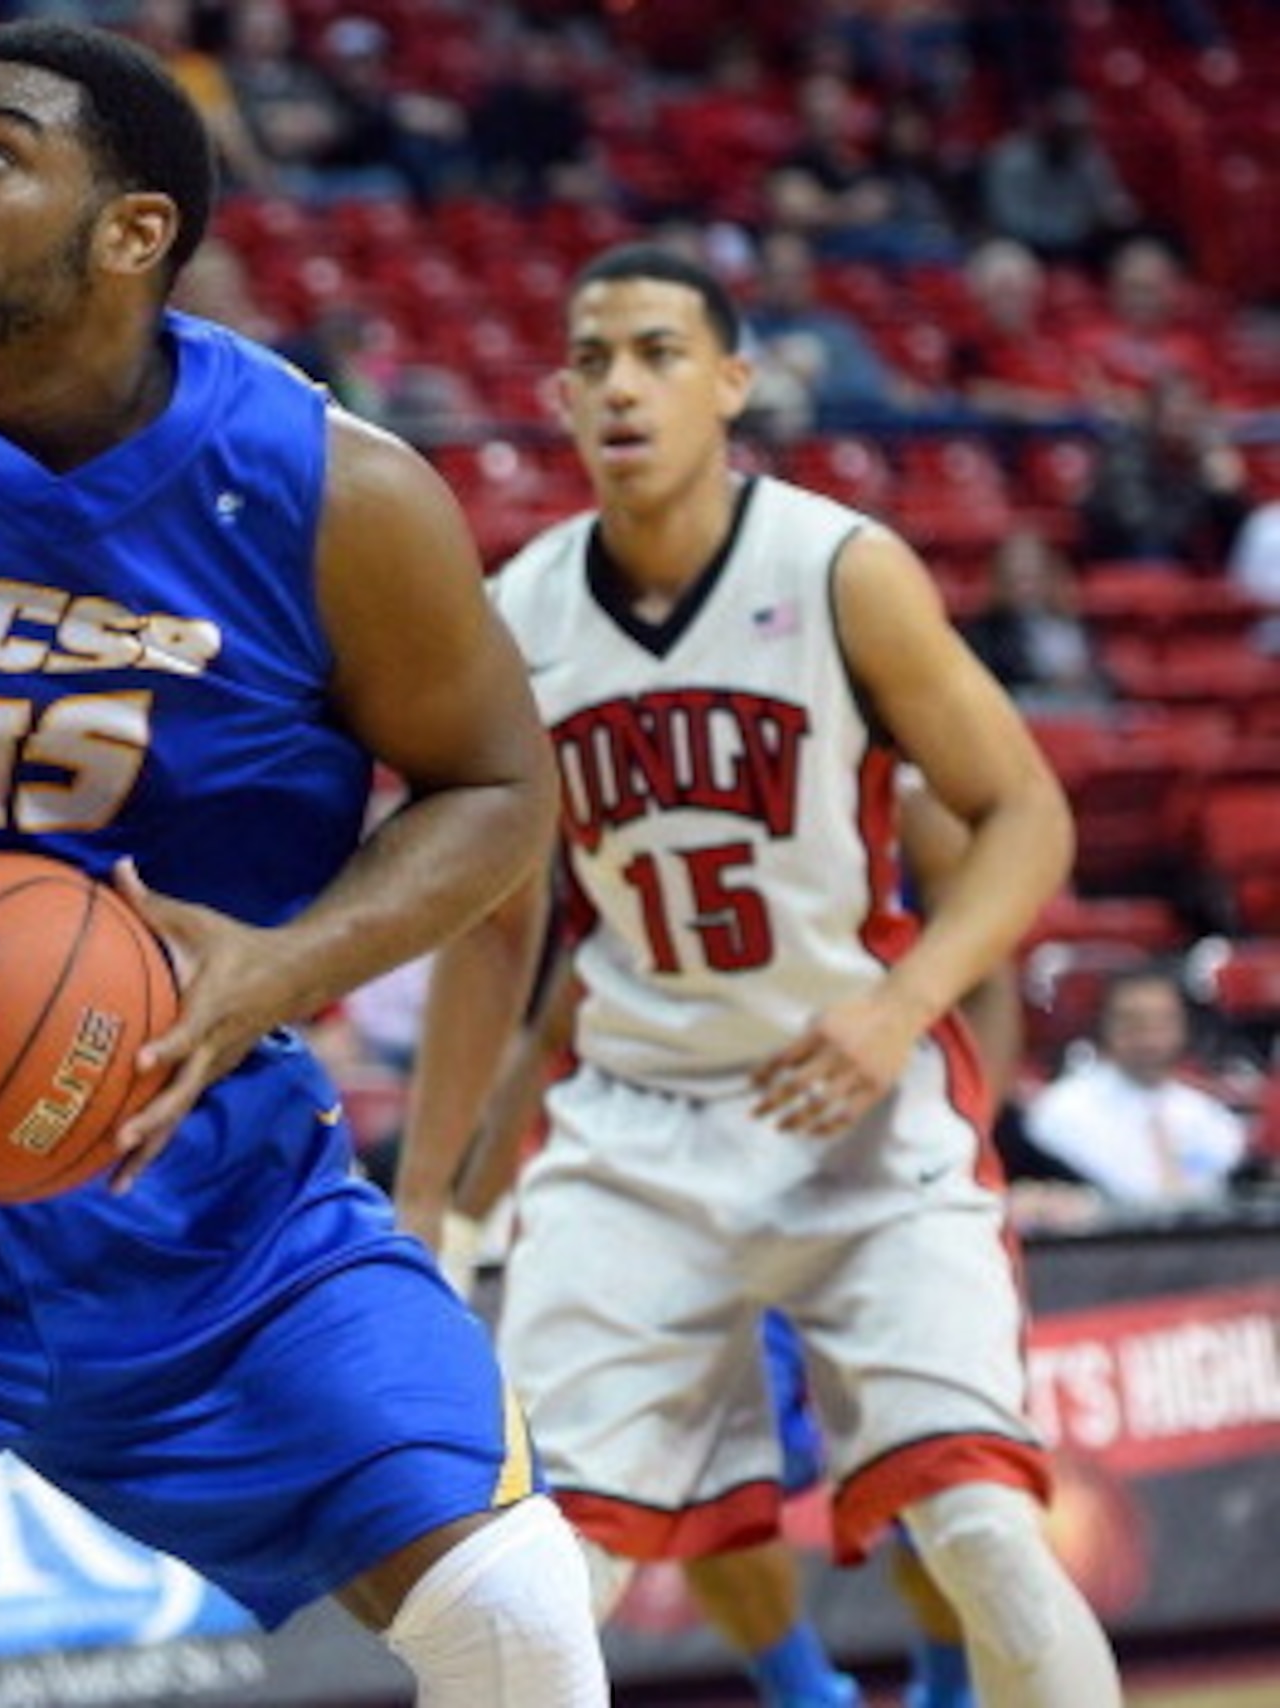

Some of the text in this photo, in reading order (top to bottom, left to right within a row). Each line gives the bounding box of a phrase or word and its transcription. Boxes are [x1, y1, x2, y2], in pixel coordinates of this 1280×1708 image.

[549, 687, 811, 856] UNLV
[623, 841, 775, 976] 15
[8, 1005, 124, 1156] ELITE
